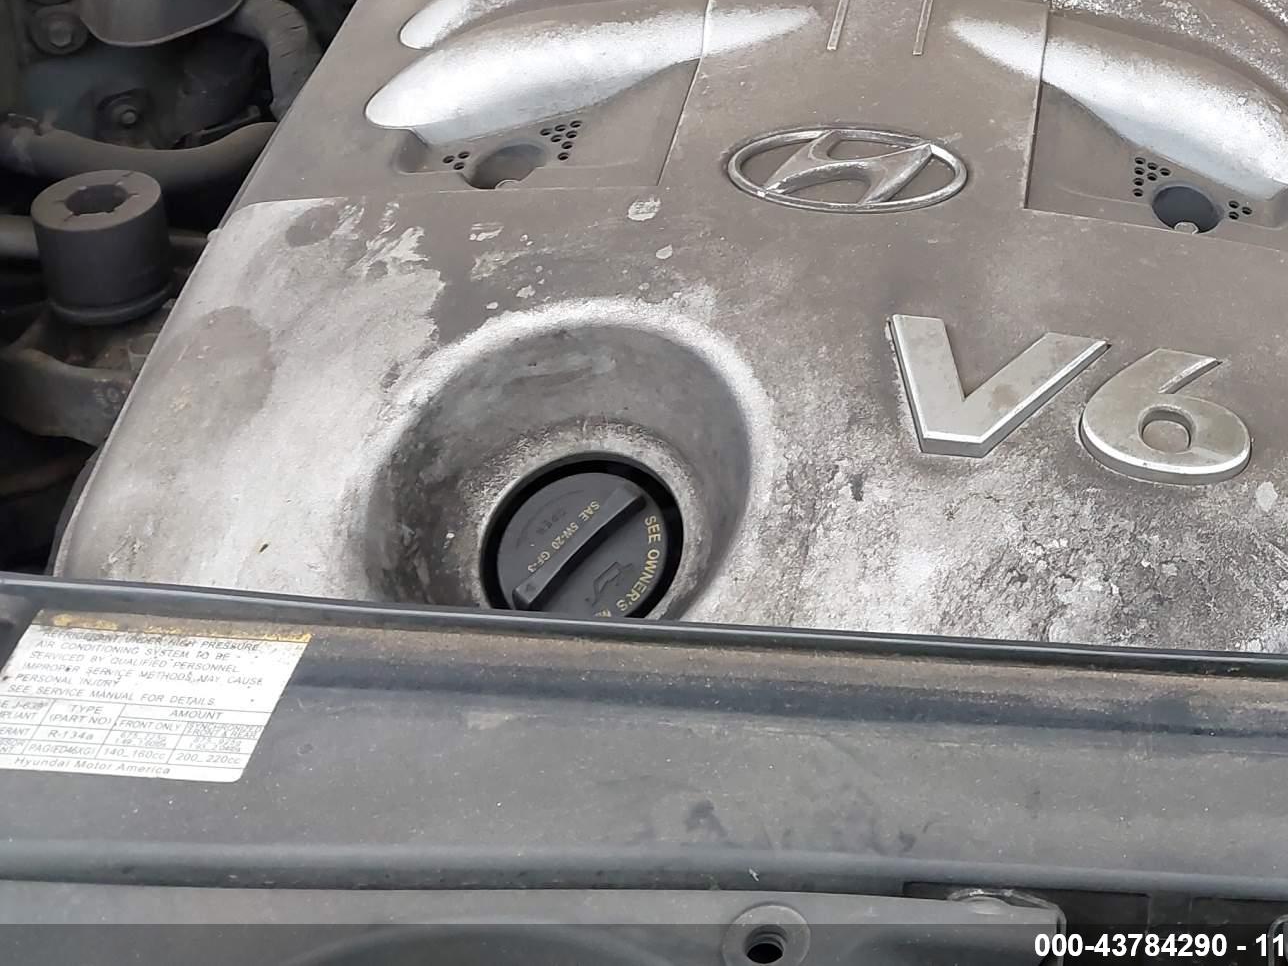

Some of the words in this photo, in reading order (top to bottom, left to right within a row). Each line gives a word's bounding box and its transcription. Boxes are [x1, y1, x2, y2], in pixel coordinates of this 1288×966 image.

[886, 313, 1252, 485] V6
[578, 500, 600, 522] SAE
[551, 521, 580, 550] 5W-20
[644, 515, 661, 543] SEE
[527, 550, 551, 573] GF-3
[616, 548, 661, 612] OWNER'S
[35, 640, 55, 648] AIR
[61, 642, 139, 654] CONDITIONING
[145, 648, 190, 658] SYSTEM
[215, 652, 230, 660] BE
[200, 641, 260, 651] PRESSURE
[30, 651, 85, 662] SERVICED
[90, 655, 105, 663] BY
[111, 657, 167, 668] QUALIFIED
[173, 661, 240, 672] PERSONNEL
[15, 673, 73, 684] PERSONAL
[86, 666, 135, 677] SERVICE
[227, 677, 263, 685] CAUSE
[8, 684, 32, 693] SEE
[36, 686, 87, 697] SERVICE
[89, 690, 134, 701] MANUAL
[140, 693, 165, 702] FOR
[169, 695, 216, 706] DETAILS
[71, 704, 105, 714] TYPE
[169, 709, 224, 720] AMOUNT
[49, 714, 88, 723] (PART
[88, 716, 112, 725] NO)
[119, 720, 154, 729] FRONT
[155, 722, 182, 731] ONLY
[48, 729, 94, 740] R-134a
[14, 757, 71, 768] Hyundai
[73, 760, 112, 771] Motor
[117, 763, 171, 775] America
